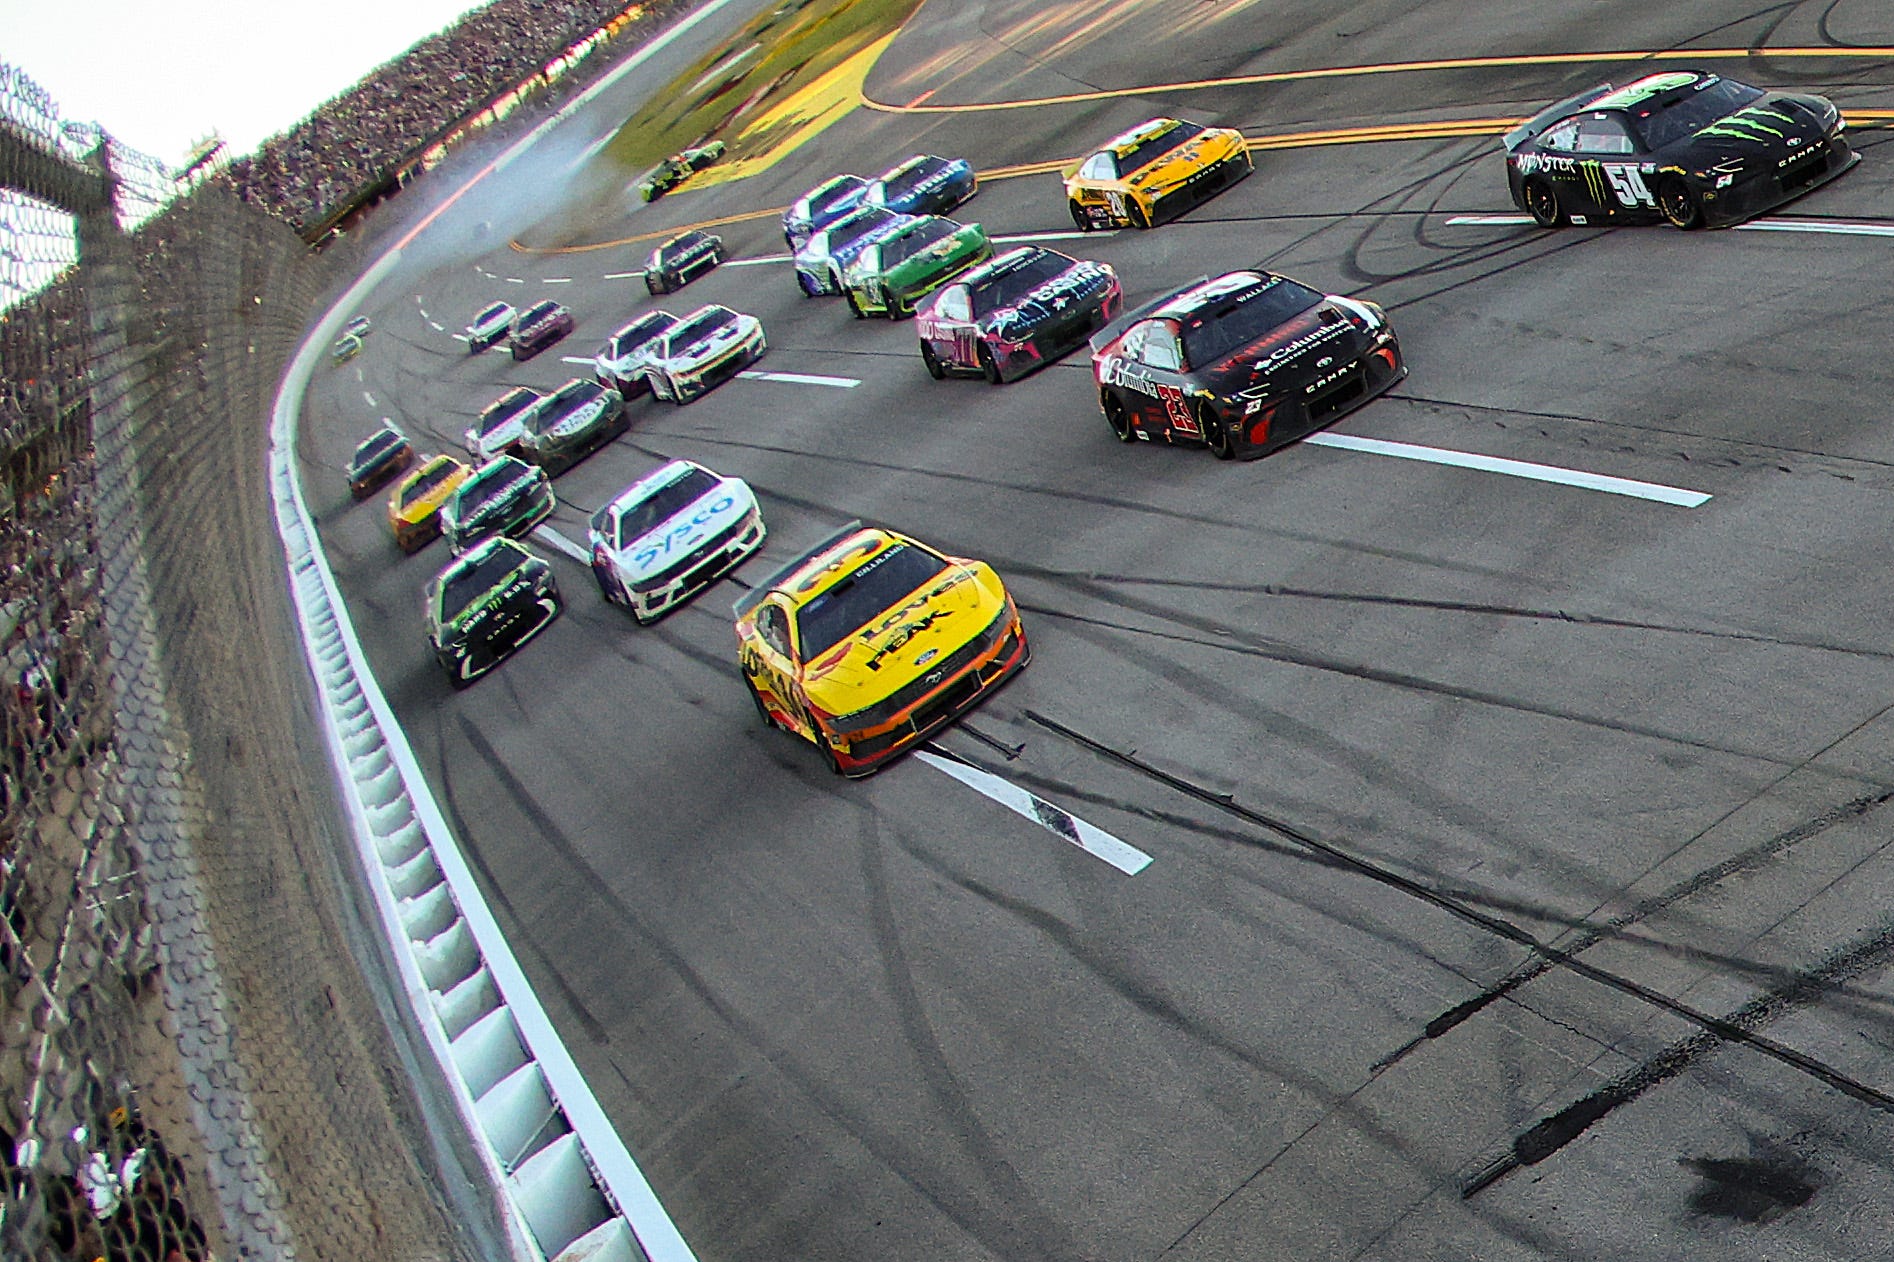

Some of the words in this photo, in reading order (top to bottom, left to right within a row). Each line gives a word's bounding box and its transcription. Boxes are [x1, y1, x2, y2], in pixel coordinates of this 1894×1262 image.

[1516, 152, 1576, 174] MONSTER
[1602, 162, 1656, 207] 54
[855, 544, 904, 579] GILLILAND
[865, 609, 956, 672] PEAK
